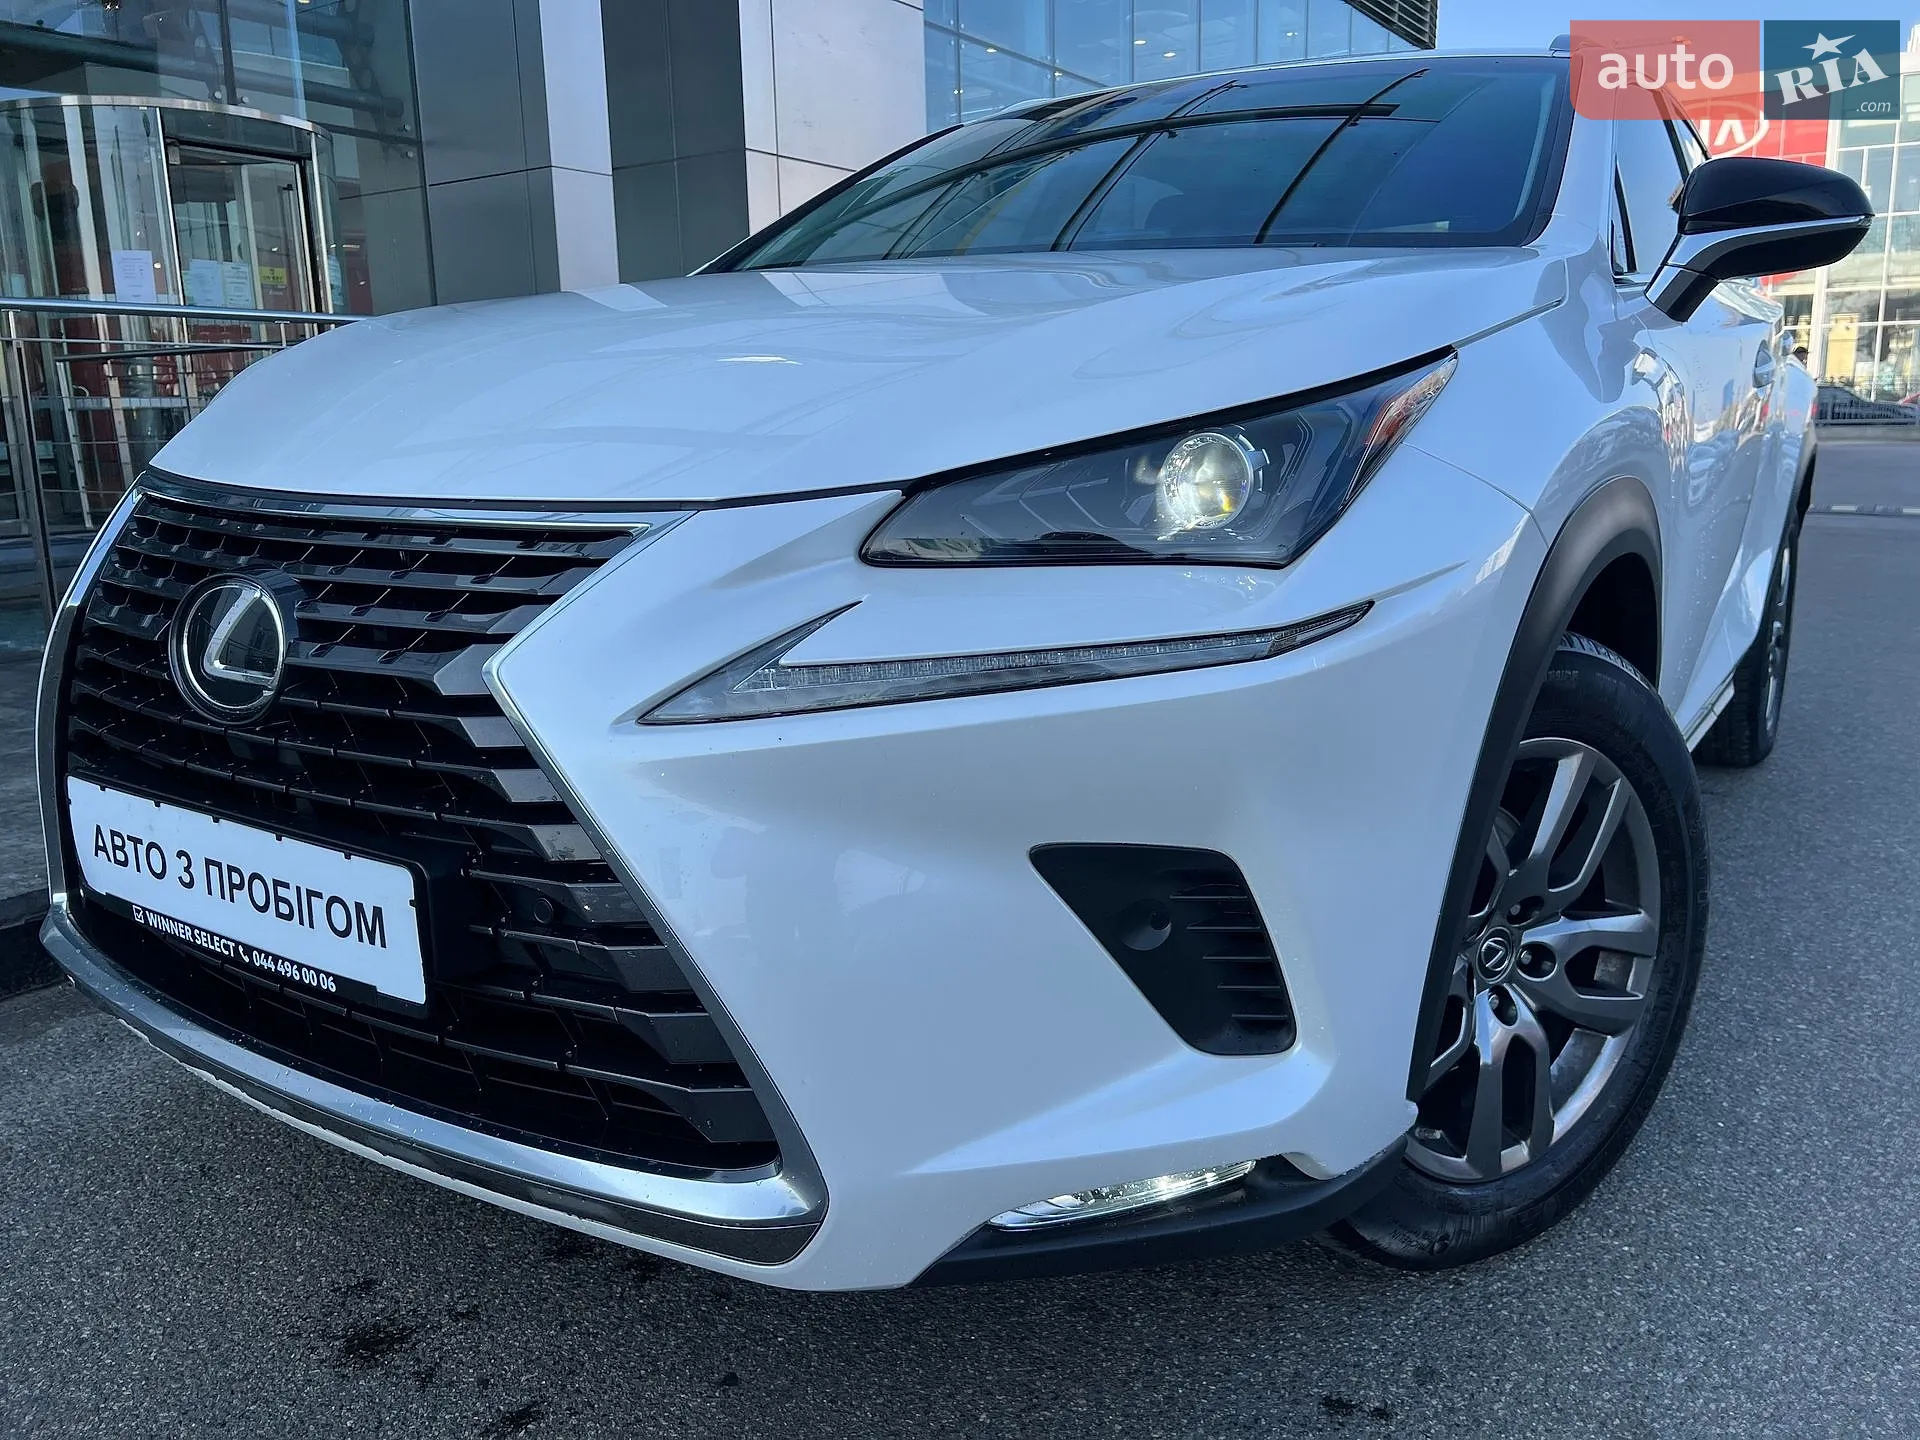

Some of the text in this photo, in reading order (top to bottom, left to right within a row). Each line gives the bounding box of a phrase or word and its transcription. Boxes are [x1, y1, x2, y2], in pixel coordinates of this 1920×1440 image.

[94, 823, 167, 880] АВТО
[204, 857, 387, 948] ПРОБІГОМ
[146, 910, 337, 993] WINNER SELECT 044 496 00 06
